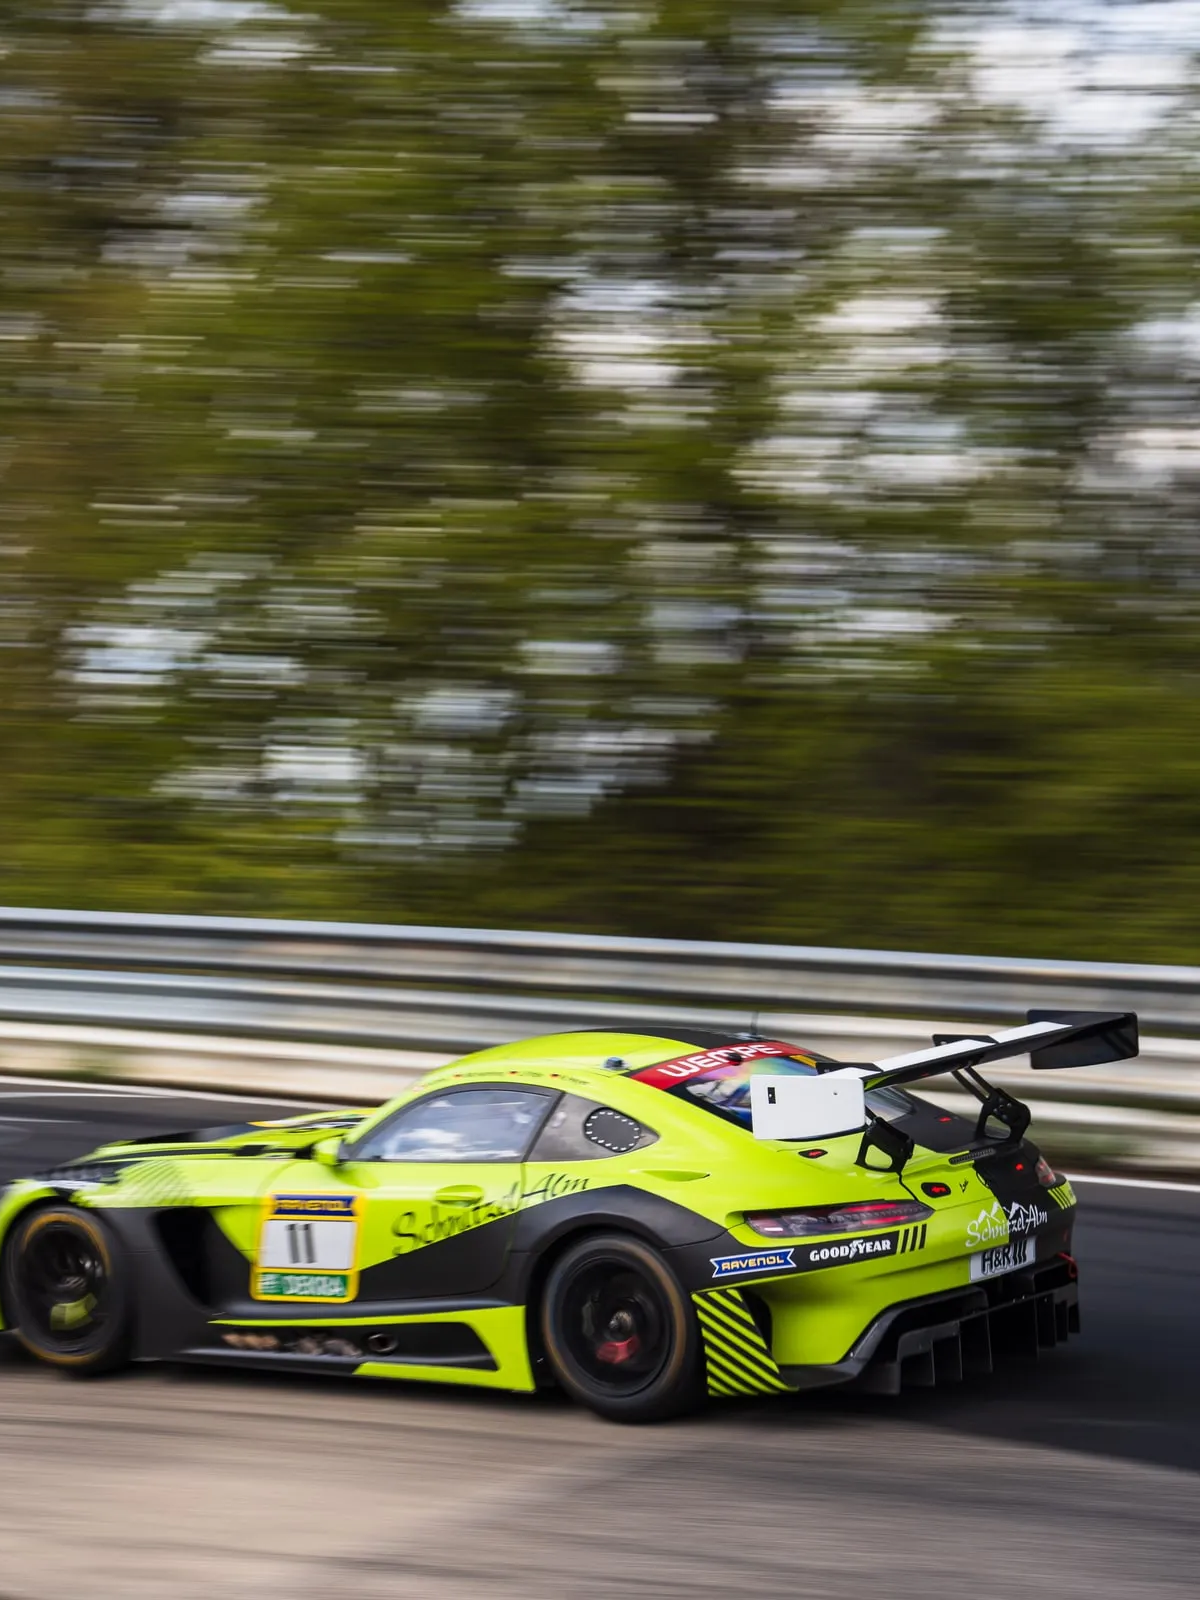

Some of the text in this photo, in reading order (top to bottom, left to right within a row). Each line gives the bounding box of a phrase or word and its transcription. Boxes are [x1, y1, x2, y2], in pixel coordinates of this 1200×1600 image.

[657, 1044, 784, 1078] WEMPE
[285, 1223, 317, 1264] 11
[809, 1239, 891, 1262] GOODYEAR
[721, 1255, 785, 1271] RAVENOL
